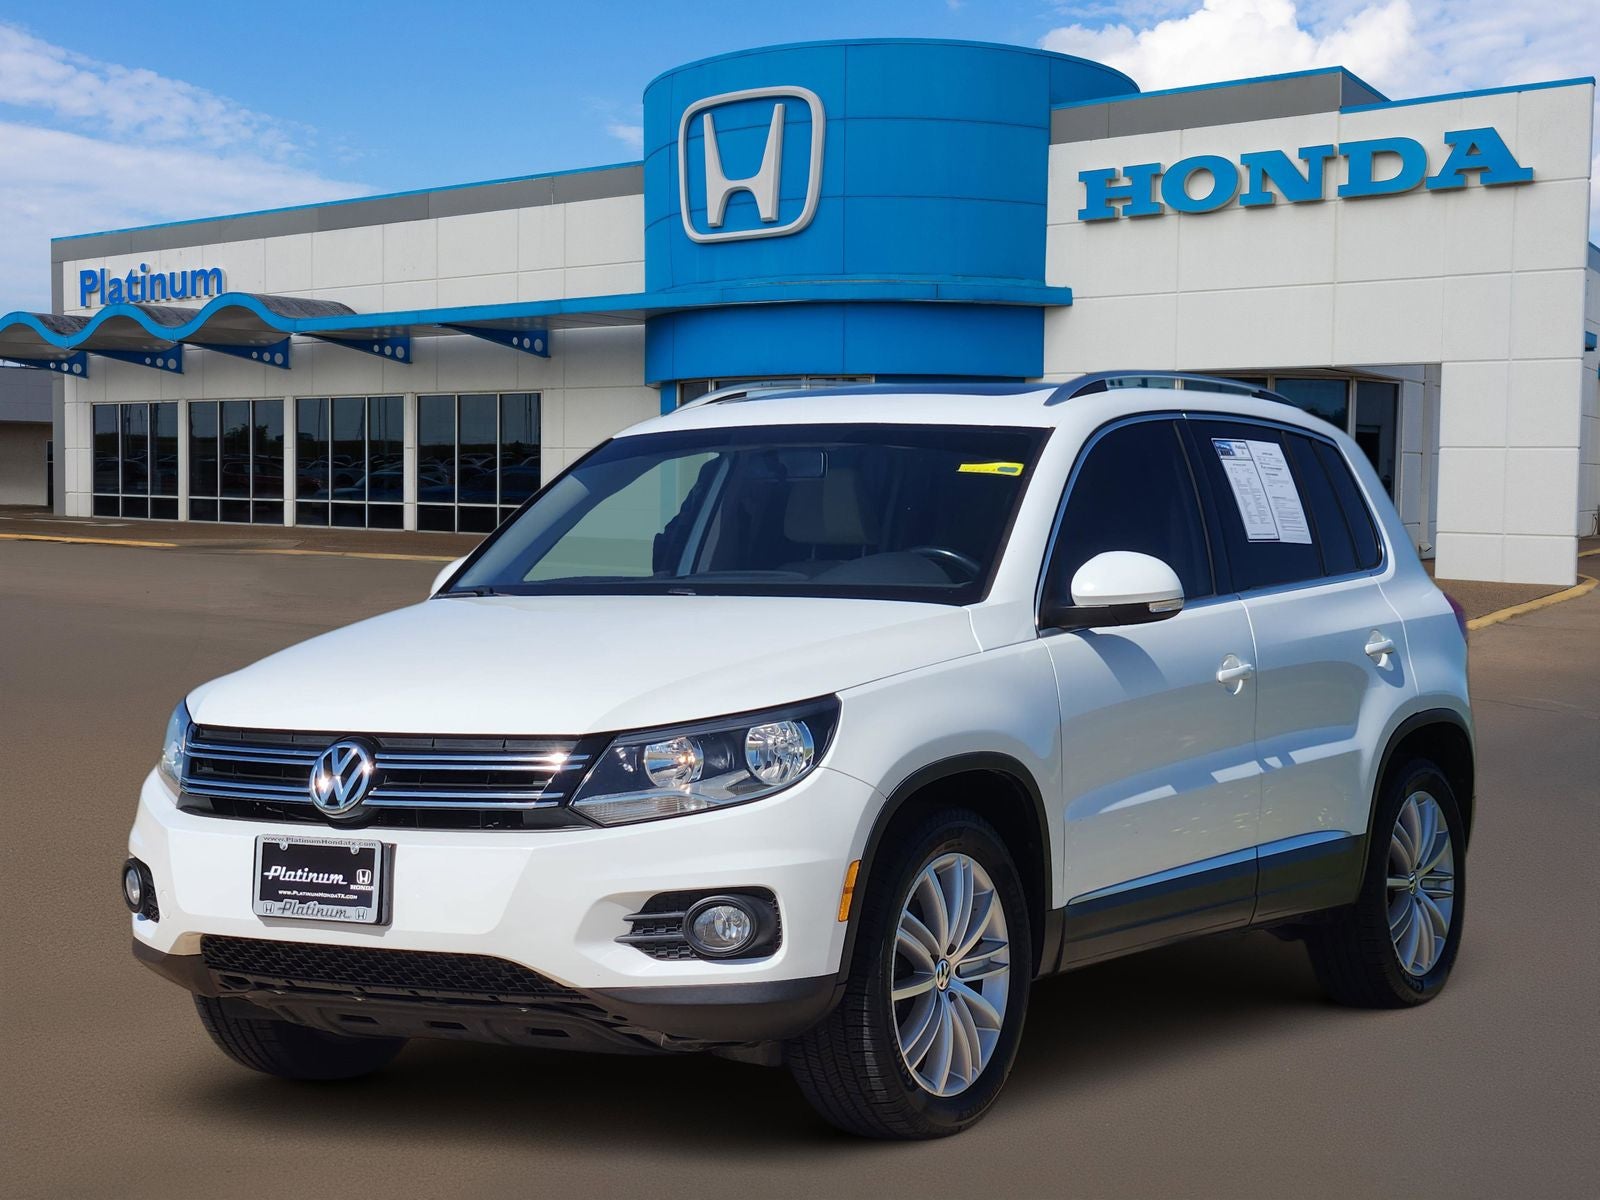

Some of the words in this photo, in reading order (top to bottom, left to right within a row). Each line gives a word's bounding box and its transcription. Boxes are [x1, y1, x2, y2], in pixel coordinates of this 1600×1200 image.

[1078, 126, 1534, 221] HONDA
[80, 263, 223, 307] Platinum
[264, 866, 347, 885] Platinum
[277, 900, 351, 919] Platinum
